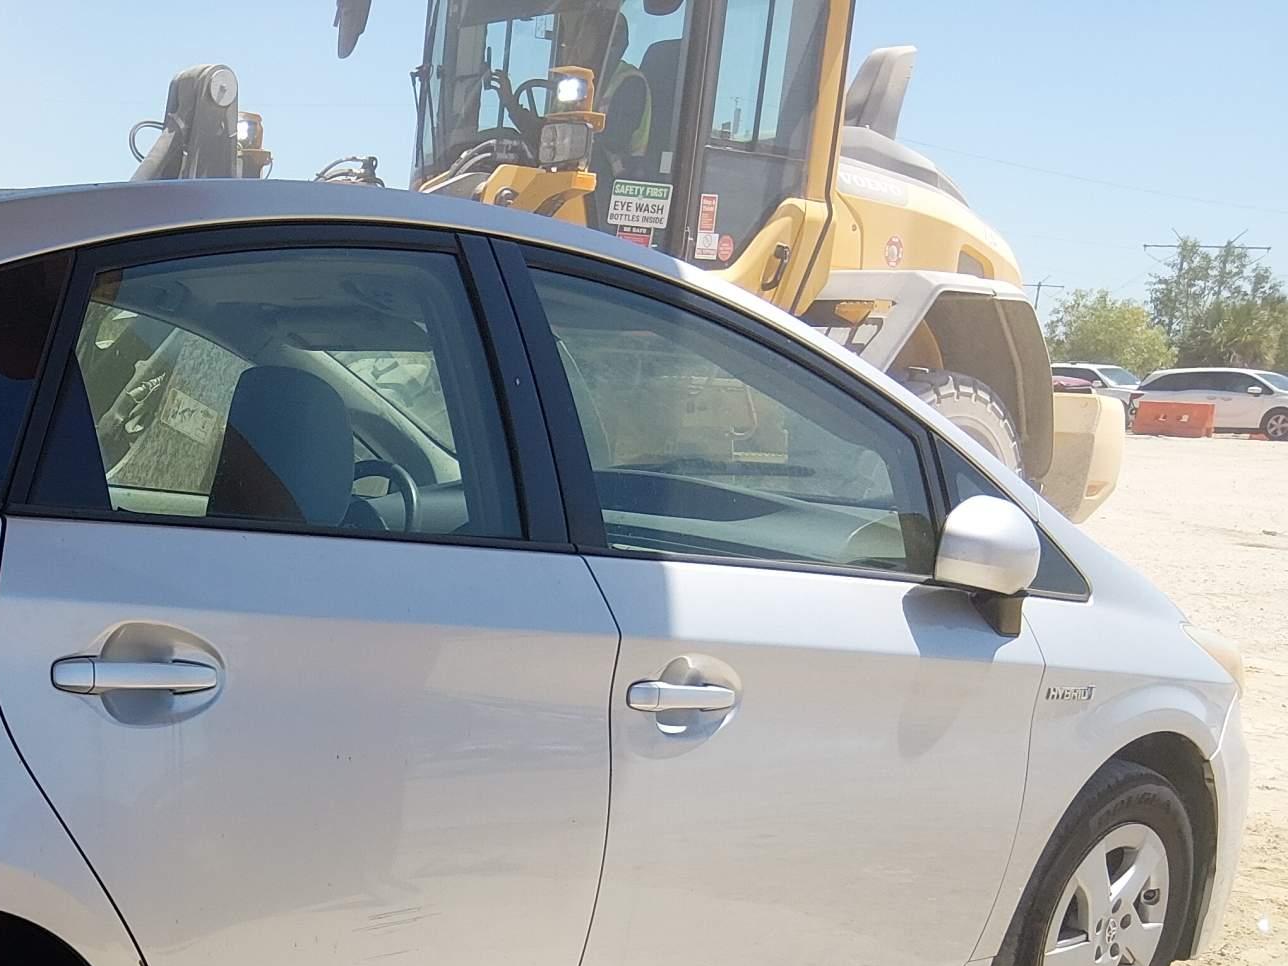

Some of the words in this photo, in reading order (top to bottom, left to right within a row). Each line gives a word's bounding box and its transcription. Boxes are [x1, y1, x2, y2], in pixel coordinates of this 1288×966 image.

[615, 184, 645, 195] SAFETY
[646, 187, 668, 198] FIRST
[614, 201, 632, 211] EYE
[635, 203, 664, 214] WASH
[610, 213, 639, 222] BOTTLES
[642, 216, 664, 224] INSIDE
